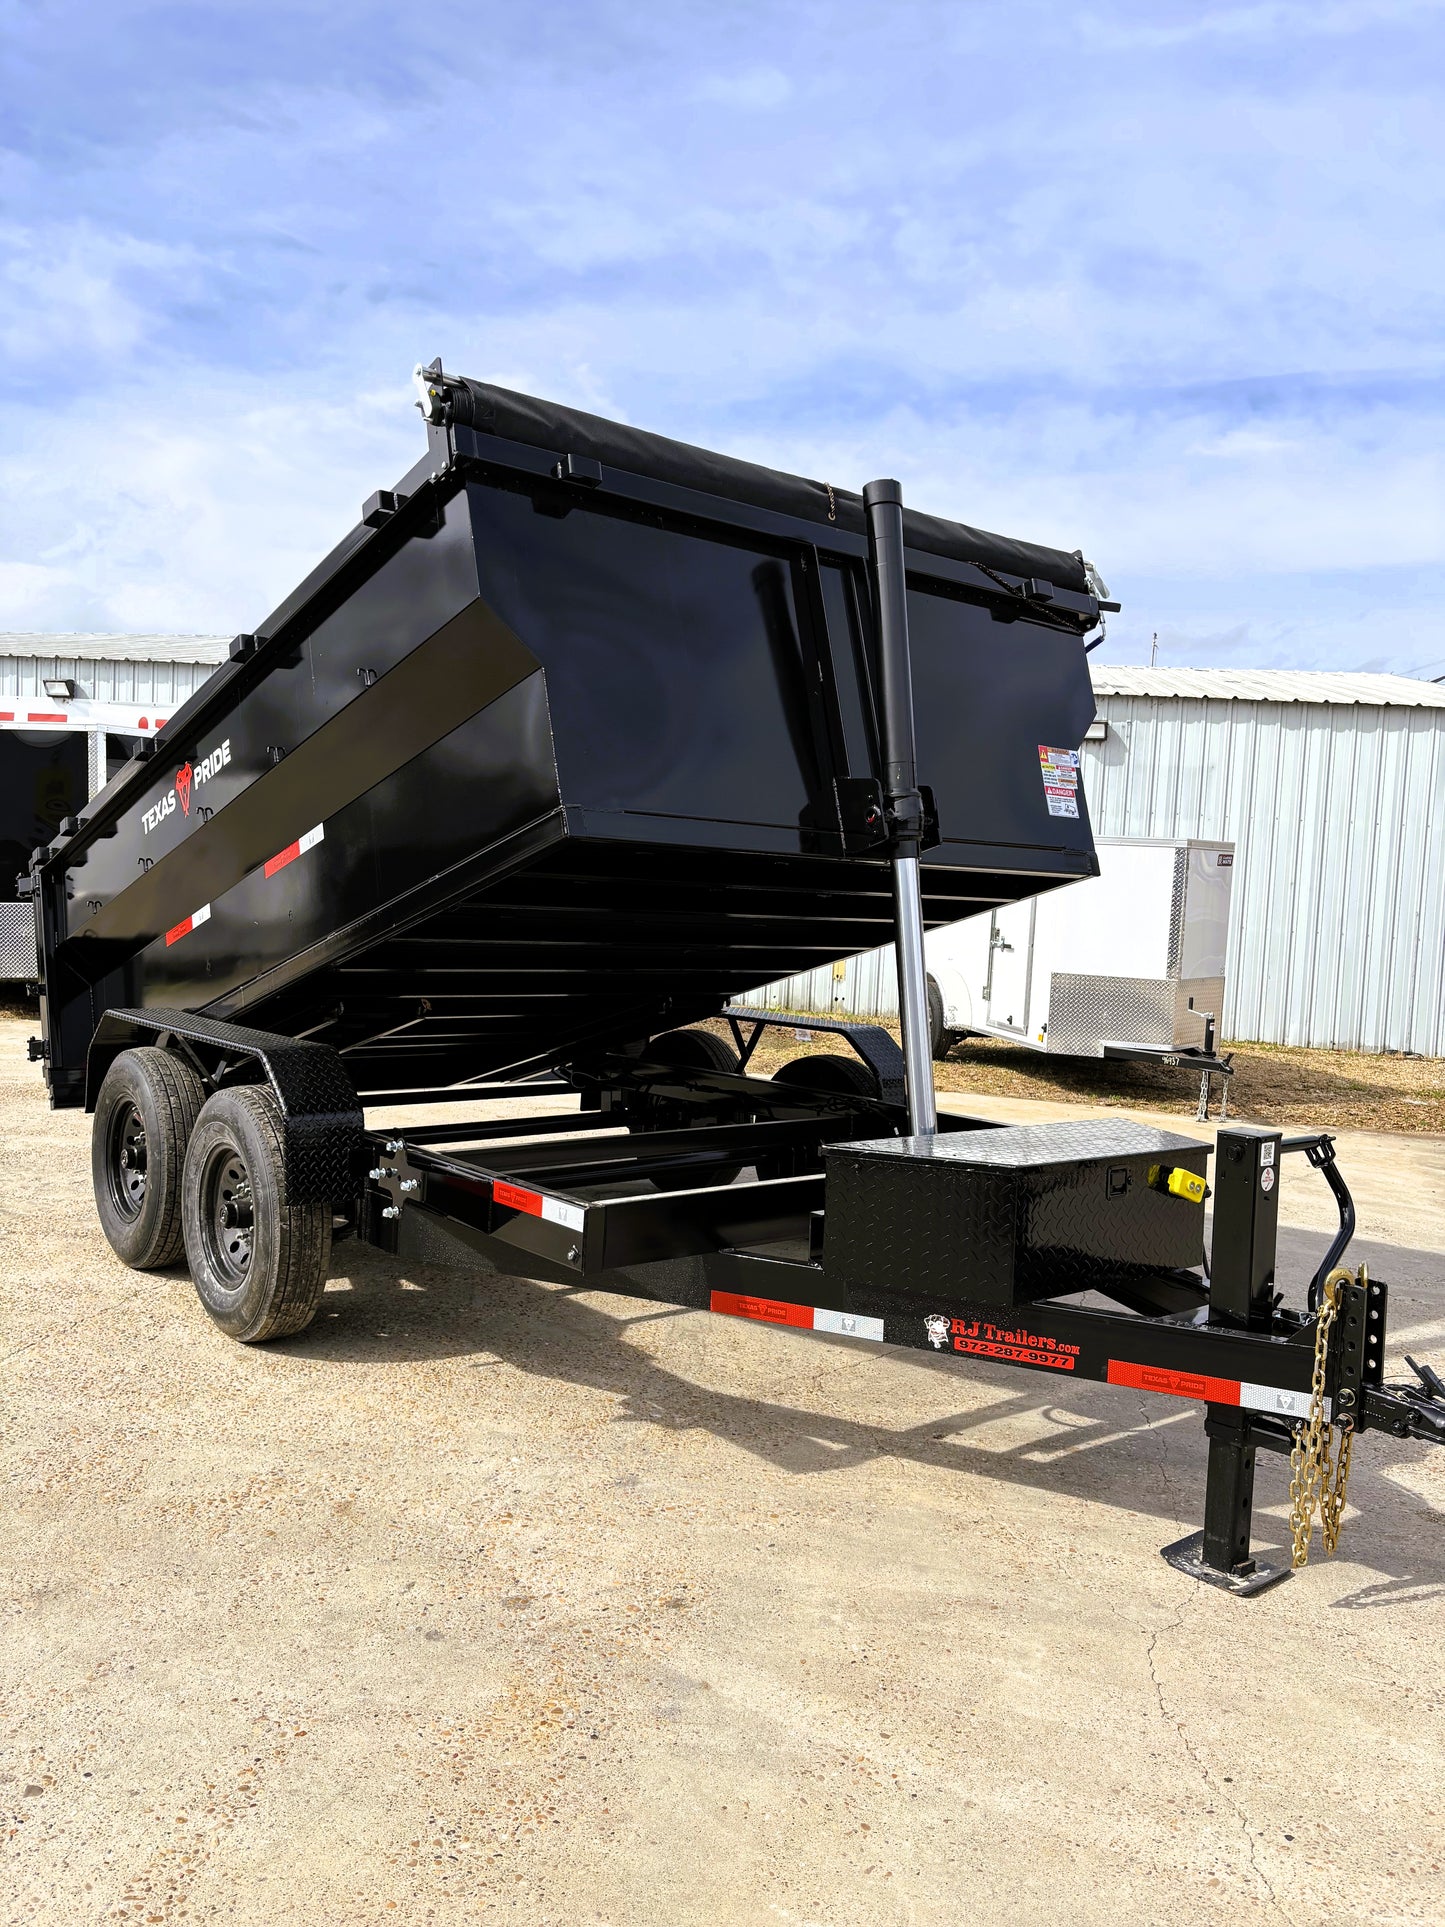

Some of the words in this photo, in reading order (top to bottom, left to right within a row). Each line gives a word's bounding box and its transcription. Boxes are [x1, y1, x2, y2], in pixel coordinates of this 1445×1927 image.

[141, 789, 176, 835] TEXAS
[193, 739, 232, 790] PRIDE
[1052, 788, 1073, 797] DANGER
[739, 1302, 758, 1311] TEXAS
[767, 1307, 786, 1316] PRIDE
[950, 1318, 981, 1337] RJ
[983, 1323, 1080, 1355] Trailers.com
[959, 1340, 1069, 1366] 972-287-9977
[1143, 1374, 1168, 1384] TEXAS
[1180, 1381, 1205, 1390] PRIDE
